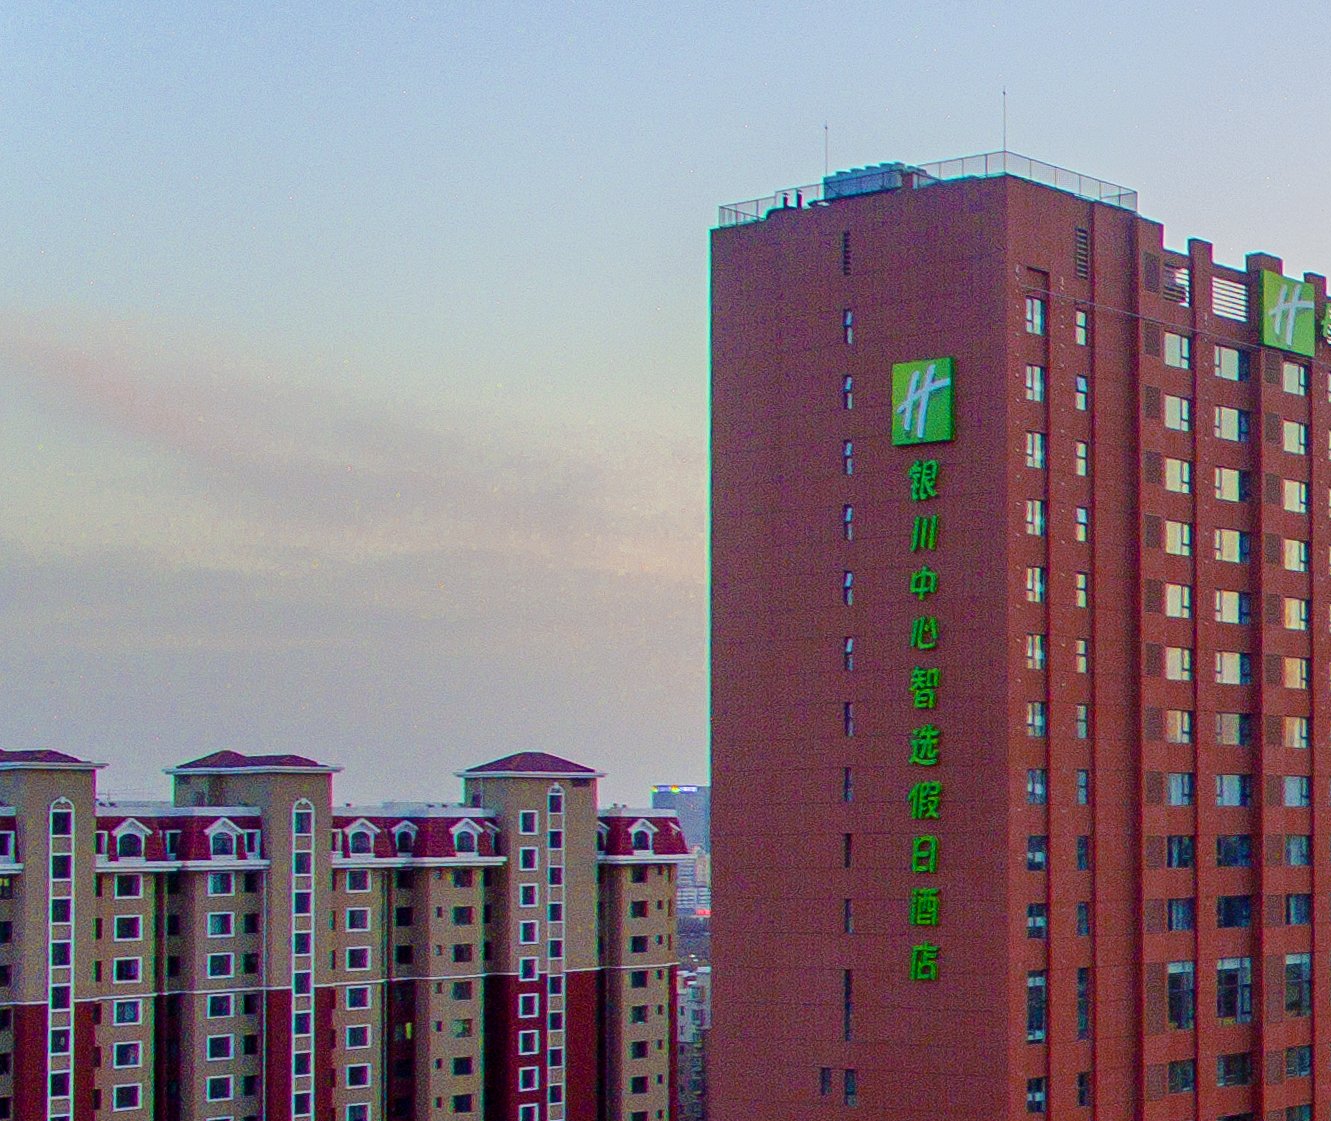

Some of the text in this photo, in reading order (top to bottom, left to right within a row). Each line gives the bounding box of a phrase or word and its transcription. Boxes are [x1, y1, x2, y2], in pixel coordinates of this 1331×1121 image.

[907, 459, 942, 982] 银川中心智选假日酒店
